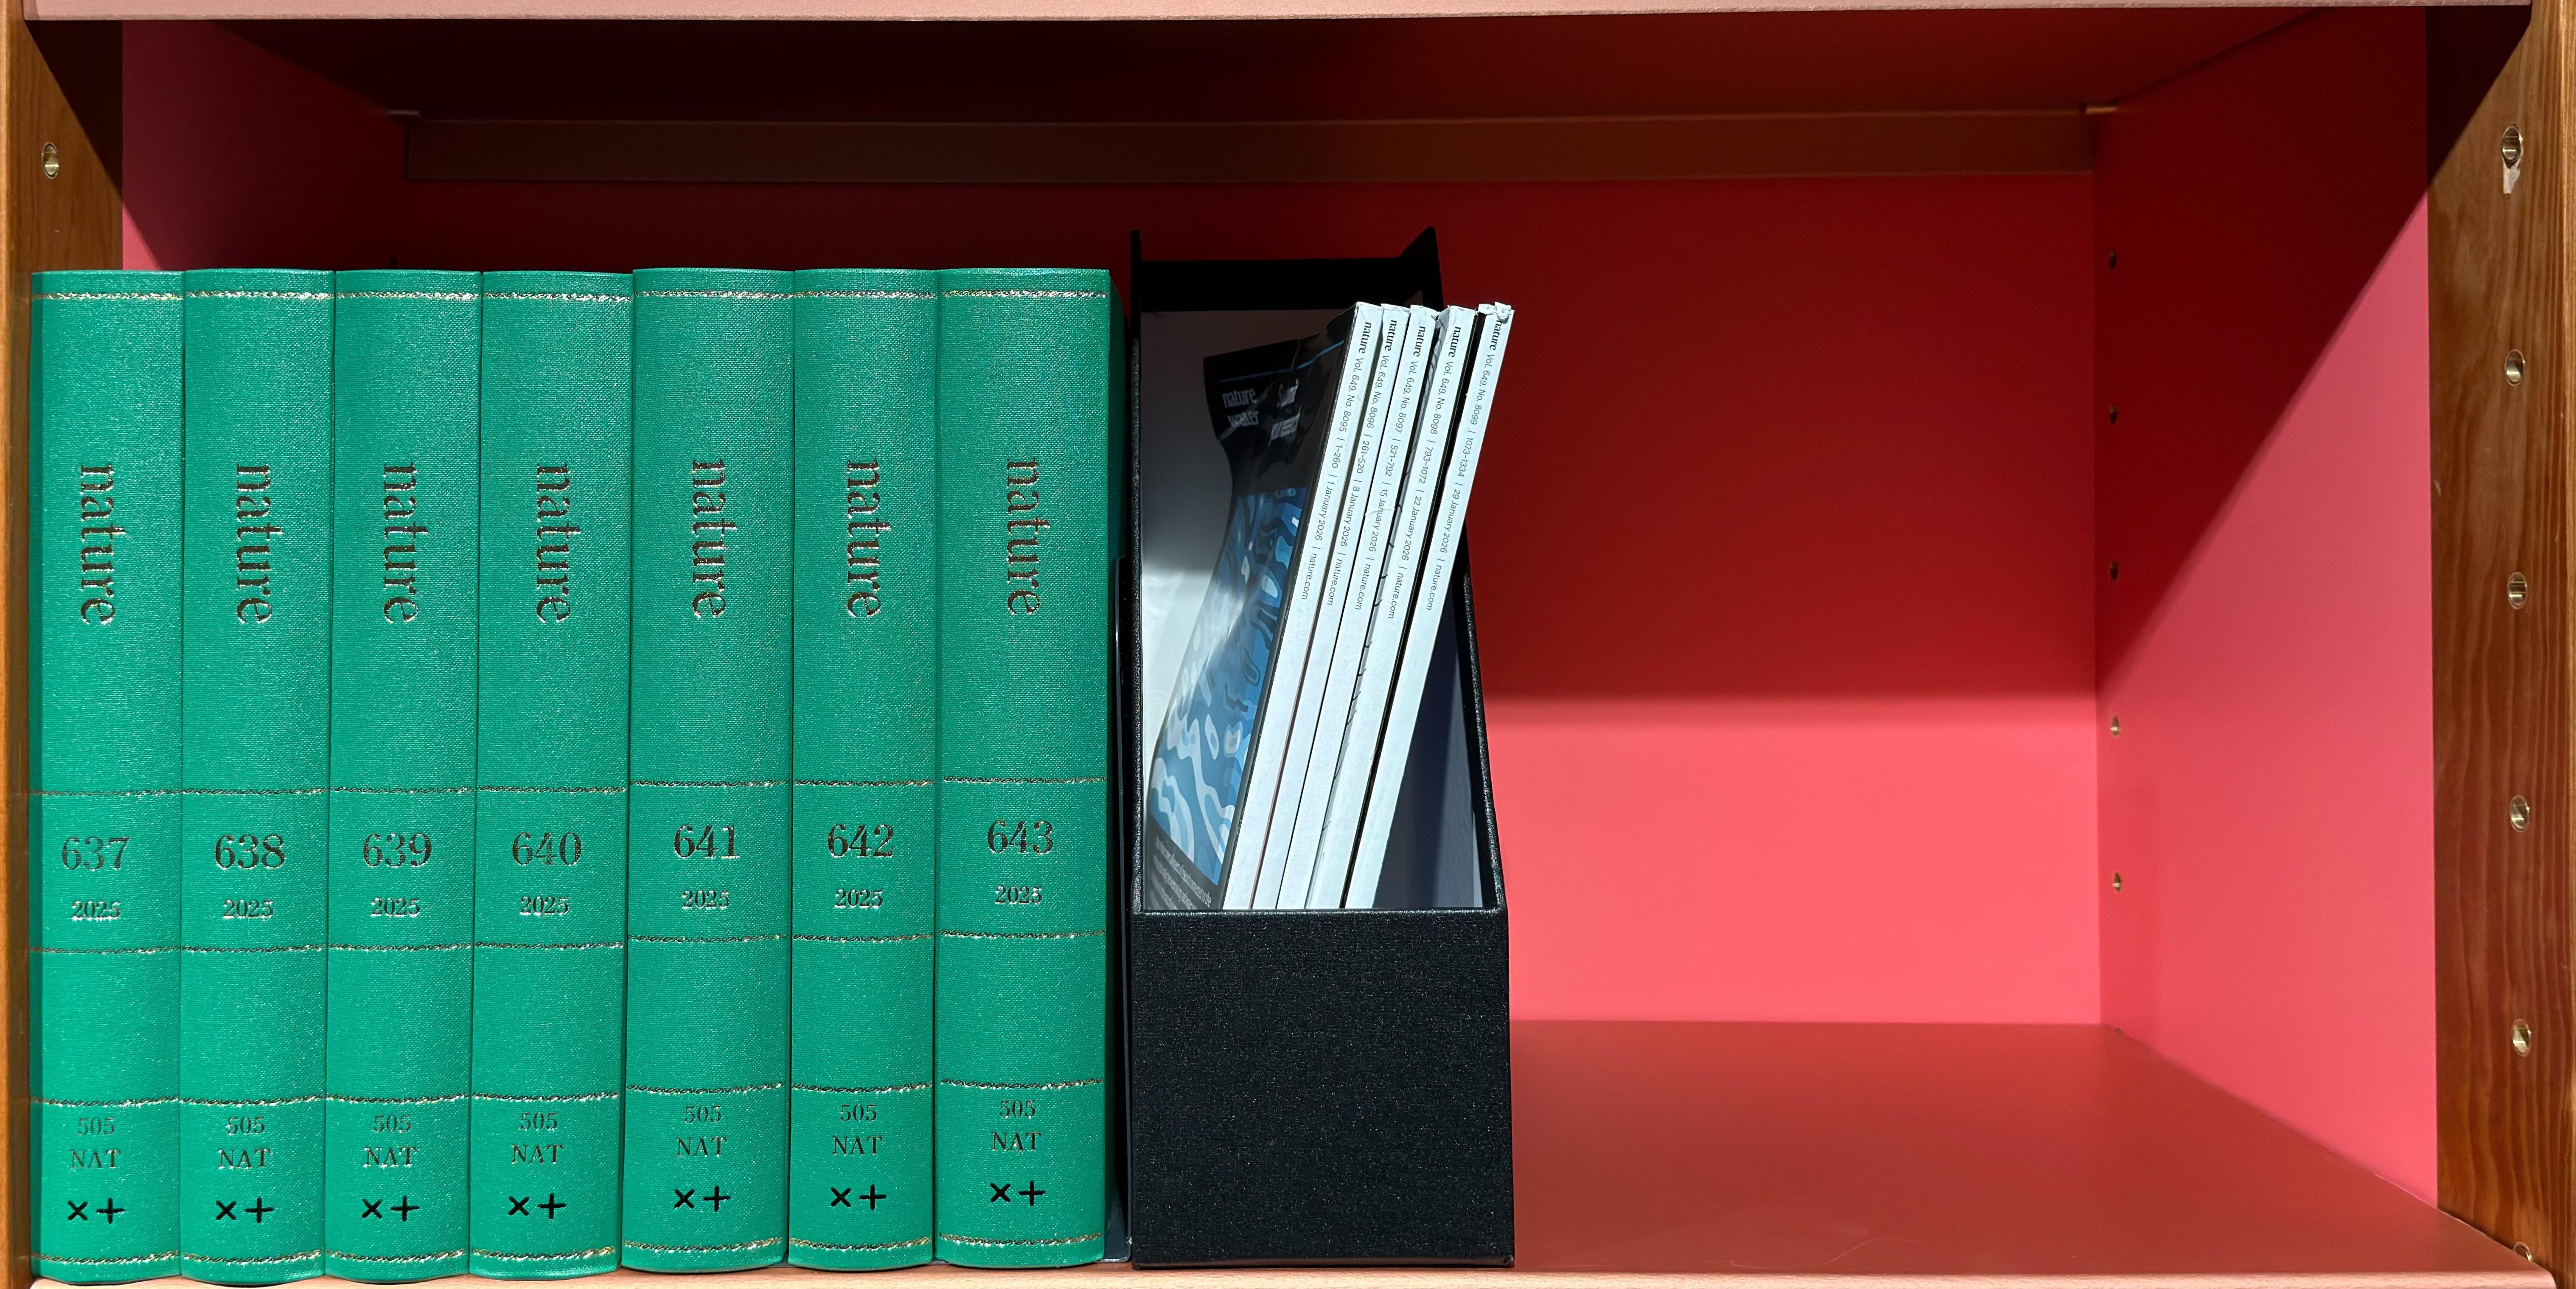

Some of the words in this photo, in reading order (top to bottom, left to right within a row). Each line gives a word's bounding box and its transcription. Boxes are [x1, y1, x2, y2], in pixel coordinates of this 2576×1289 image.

[1358, 322, 1372, 354] nature
[1384, 320, 1397, 351] nature
[1413, 326, 1426, 357] nature
[1448, 326, 1461, 358] nature
[1489, 320, 1503, 351] nature
[1353, 358, 1364, 372] Vol.
[1380, 355, 1390, 369] Vol.
[1408, 361, 1419, 375] Vol.
[1443, 362, 1454, 376] Vol.
[1484, 354, 1495, 368] Vol.
[1222, 388, 1257, 408] nature
[1345, 394, 1355, 408] No.
[1372, 391, 1382, 405] No.
[1400, 397, 1410, 410] No.
[1435, 398, 1445, 411] No.
[1476, 389, 1486, 402] No.
[1339, 410, 1351, 432] 8095
[1367, 407, 1378, 429] 8096
[1395, 412, 1406, 433] 8097
[1430, 413, 1442, 435] 8098
[1470, 404, 1482, 425] 8099
[1319, 486, 1334, 518] January
[1380, 489, 1388, 497] 15
[1414, 496, 1422, 506] 22
[1452, 489, 1461, 500] 29
[1344, 493, 1358, 525] January
[1372, 498, 1386, 530] January
[1444, 500, 1459, 532] January
[1315, 520, 1325, 541] 2026
[1405, 507, 1420, 539] January
[79, 462, 127, 623] nature
[236, 463, 284, 623] nature
[383, 461, 429, 621] nature
[536, 463, 582, 621] nature
[691, 458, 737, 615] nature
[846, 458, 891, 617] nature
[1006, 457, 1051, 615] nature
[1340, 525, 1350, 547] 2026
[1369, 531, 1379, 552] 2026
[1440, 532, 1450, 553] 2026
[1401, 540, 1411, 561] 2026
[1301, 553, 1317, 600] nature.com
[1327, 559, 1342, 605] nature.com
[1355, 564, 1371, 610] nature.com
[1388, 573, 1403, 619] nature.com
[1426, 565, 1442, 610] nature.com
[673, 825, 736, 858] 641
[827, 823, 894, 857] 642
[987, 820, 1054, 854] 643
[61, 836, 130, 871] 637
[214, 834, 286, 869] 638
[362, 833, 432, 867] 639
[511, 831, 582, 865] 640
[520, 896, 569, 914] 2025
[682, 890, 730, 907] 2025
[836, 889, 884, 907] 2025
[995, 886, 1043, 904] 2025
[72, 901, 121, 918] 2025
[223, 899, 274, 918] 2025
[372, 897, 421, 915] 2025
[684, 1105, 722, 1123] 505
[840, 1104, 877, 1121] 505
[999, 1099, 1036, 1118] 505
[78, 1118, 115, 1135] 505
[227, 1116, 265, 1134] 505
[373, 1115, 411, 1132] 505
[520, 1112, 558, 1129] 505
[677, 1136, 727, 1156] NAT
[832, 1135, 883, 1155] NAT
[993, 1132, 1042, 1151] NAT
[70, 1149, 121, 1168] NAT
[220, 1148, 272, 1168] NAT
[366, 1146, 417, 1165] NAT
[511, 1144, 564, 1164] NAT
